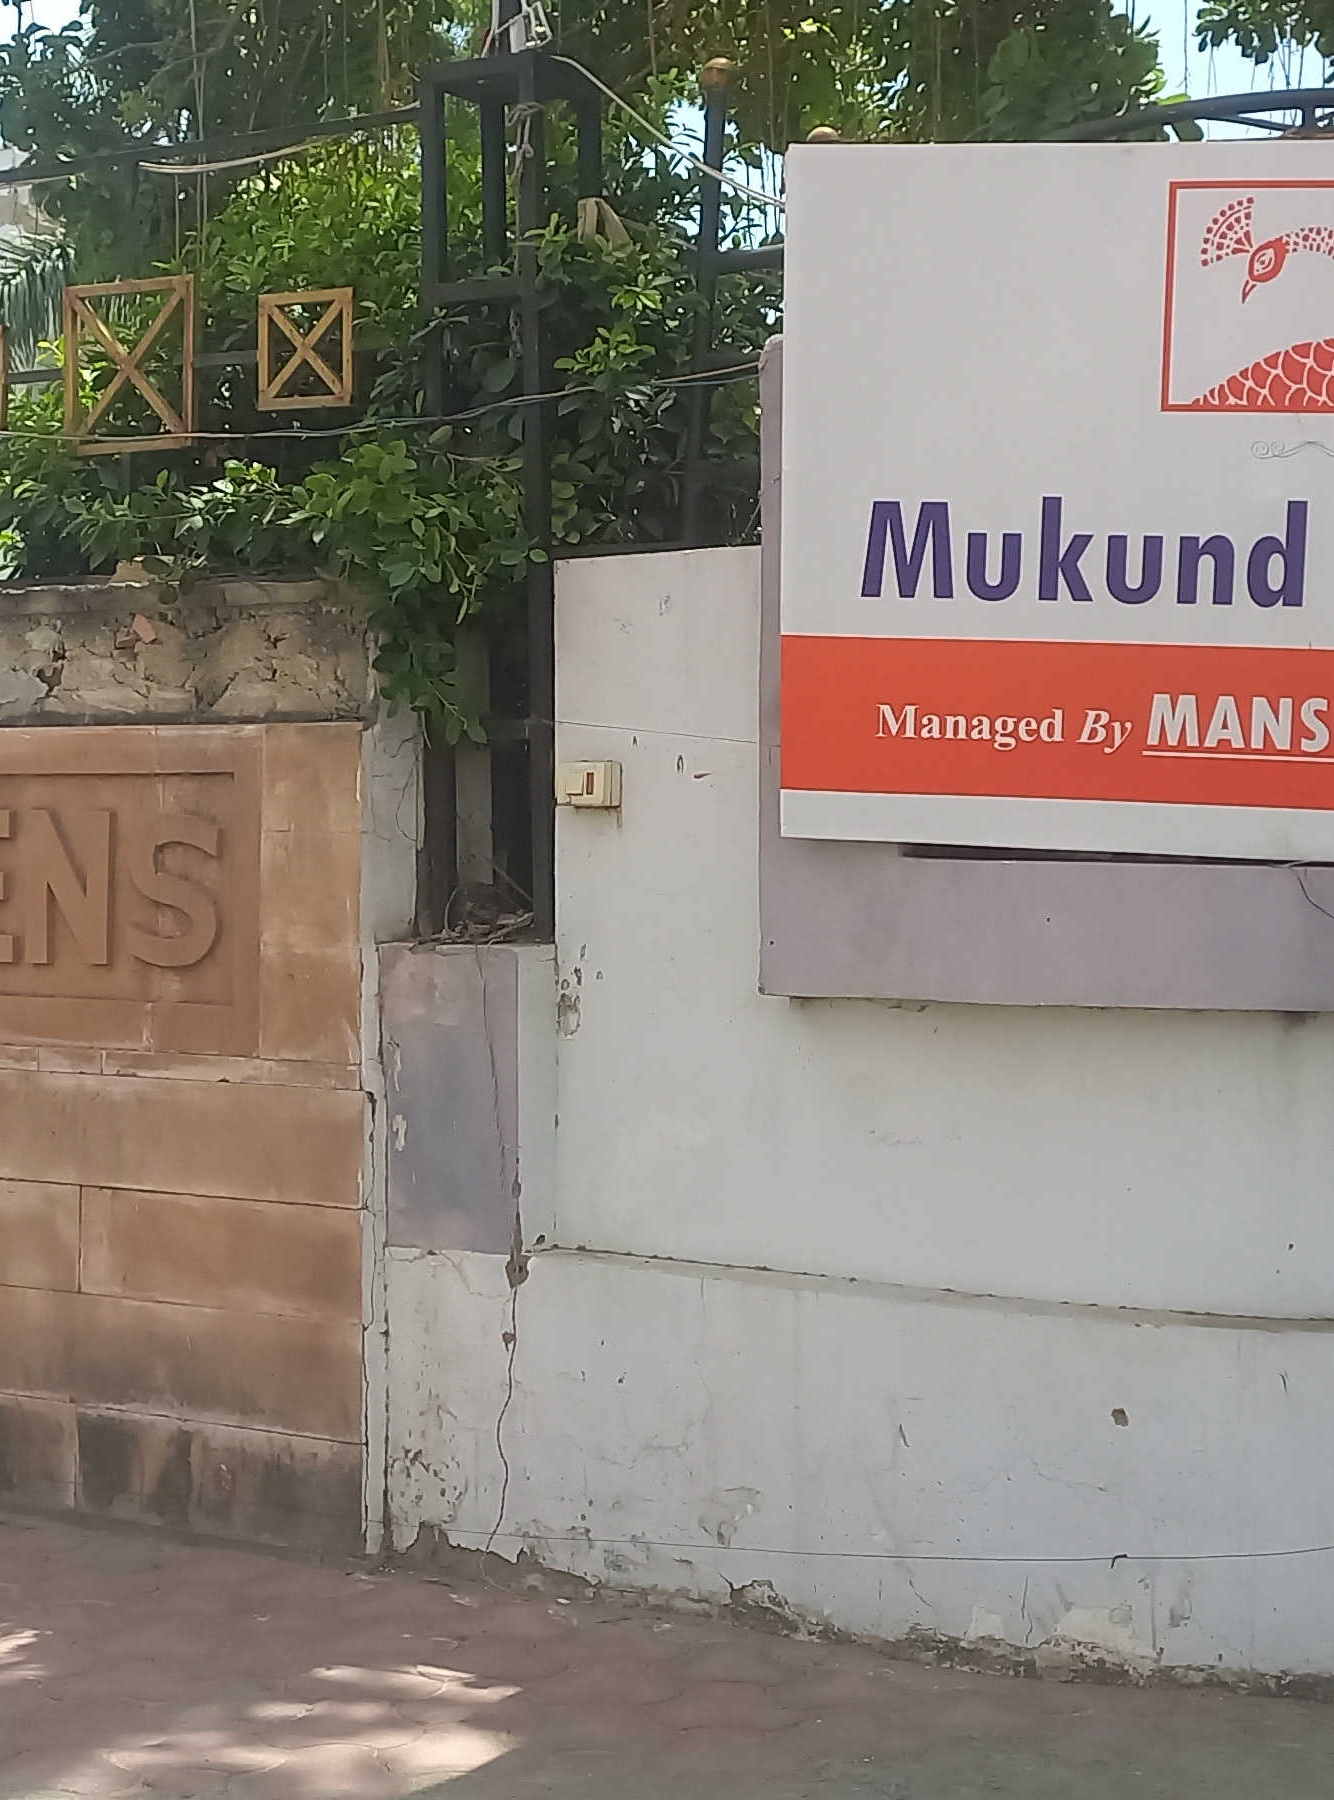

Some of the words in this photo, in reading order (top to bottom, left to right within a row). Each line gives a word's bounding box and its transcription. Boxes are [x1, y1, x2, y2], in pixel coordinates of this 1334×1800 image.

[860, 496, 1309, 607] Mukund
[874, 703, 1066, 746] Managed
[1078, 706, 1133, 756] By
